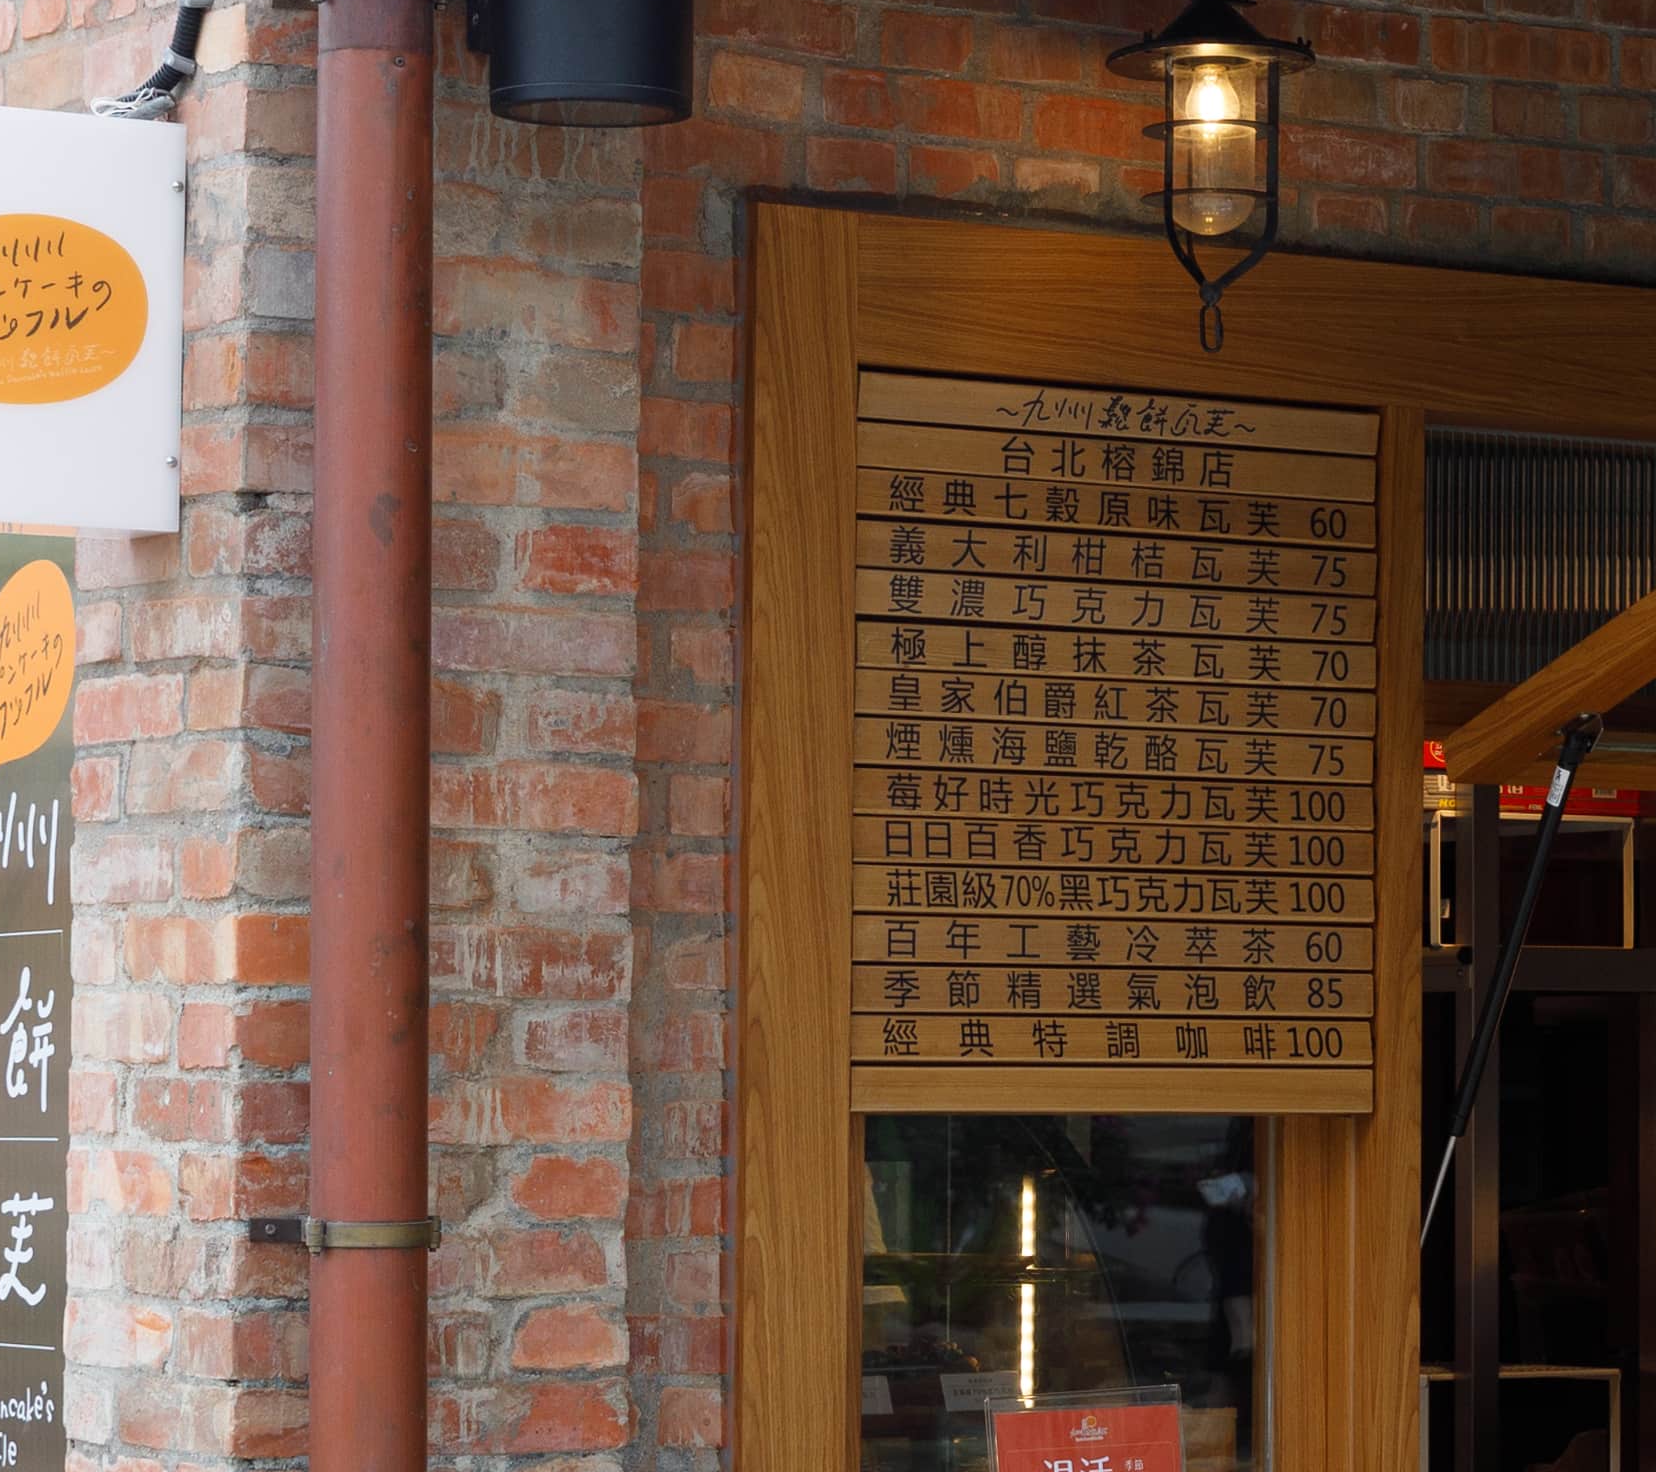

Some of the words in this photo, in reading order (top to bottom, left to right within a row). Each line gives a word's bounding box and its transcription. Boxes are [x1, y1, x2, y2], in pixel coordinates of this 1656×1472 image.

[1000, 436, 1234, 489] 台北榕錦店
[889, 474, 1280, 538] 經典七穀原味瓦芙
[1310, 508, 1346, 538] 60
[889, 525, 1280, 586] 義大利柑桔瓦芙
[1311, 555, 1346, 587] 75
[889, 574, 1280, 634] 雙濃巧克力瓦芙
[1311, 603, 1346, 636] 75
[891, 626, 1281, 682] 極上醇抹茶瓦芙
[1311, 650, 1348, 682] 70
[888, 674, 1279, 728] 皇家伯爵紅茶瓦芙
[1310, 696, 1346, 728] 70
[885, 722, 1277, 776] 煙燻海鹽乾酪瓦芙
[1308, 744, 1344, 776] 75
[886, 772, 1278, 822] 莓好時光巧克力瓦芙
[1290, 790, 1344, 822] 100
[885, 821, 1278, 868] 日日百香巧克力瓦芙
[1290, 835, 1344, 867] 100
[886, 869, 1278, 915] 莊園級70%黑巧克力瓦芙
[1290, 881, 1344, 914] 100
[885, 919, 1276, 964] 百年工藝冷萃茶
[1305, 932, 1343, 963] 60
[884, 970, 1276, 1011] 季節精選氣泡飲
[1307, 977, 1343, 1009] 85
[883, 1018, 1276, 1061] 經典特調咖啡
[1288, 1028, 1343, 1059] 100
